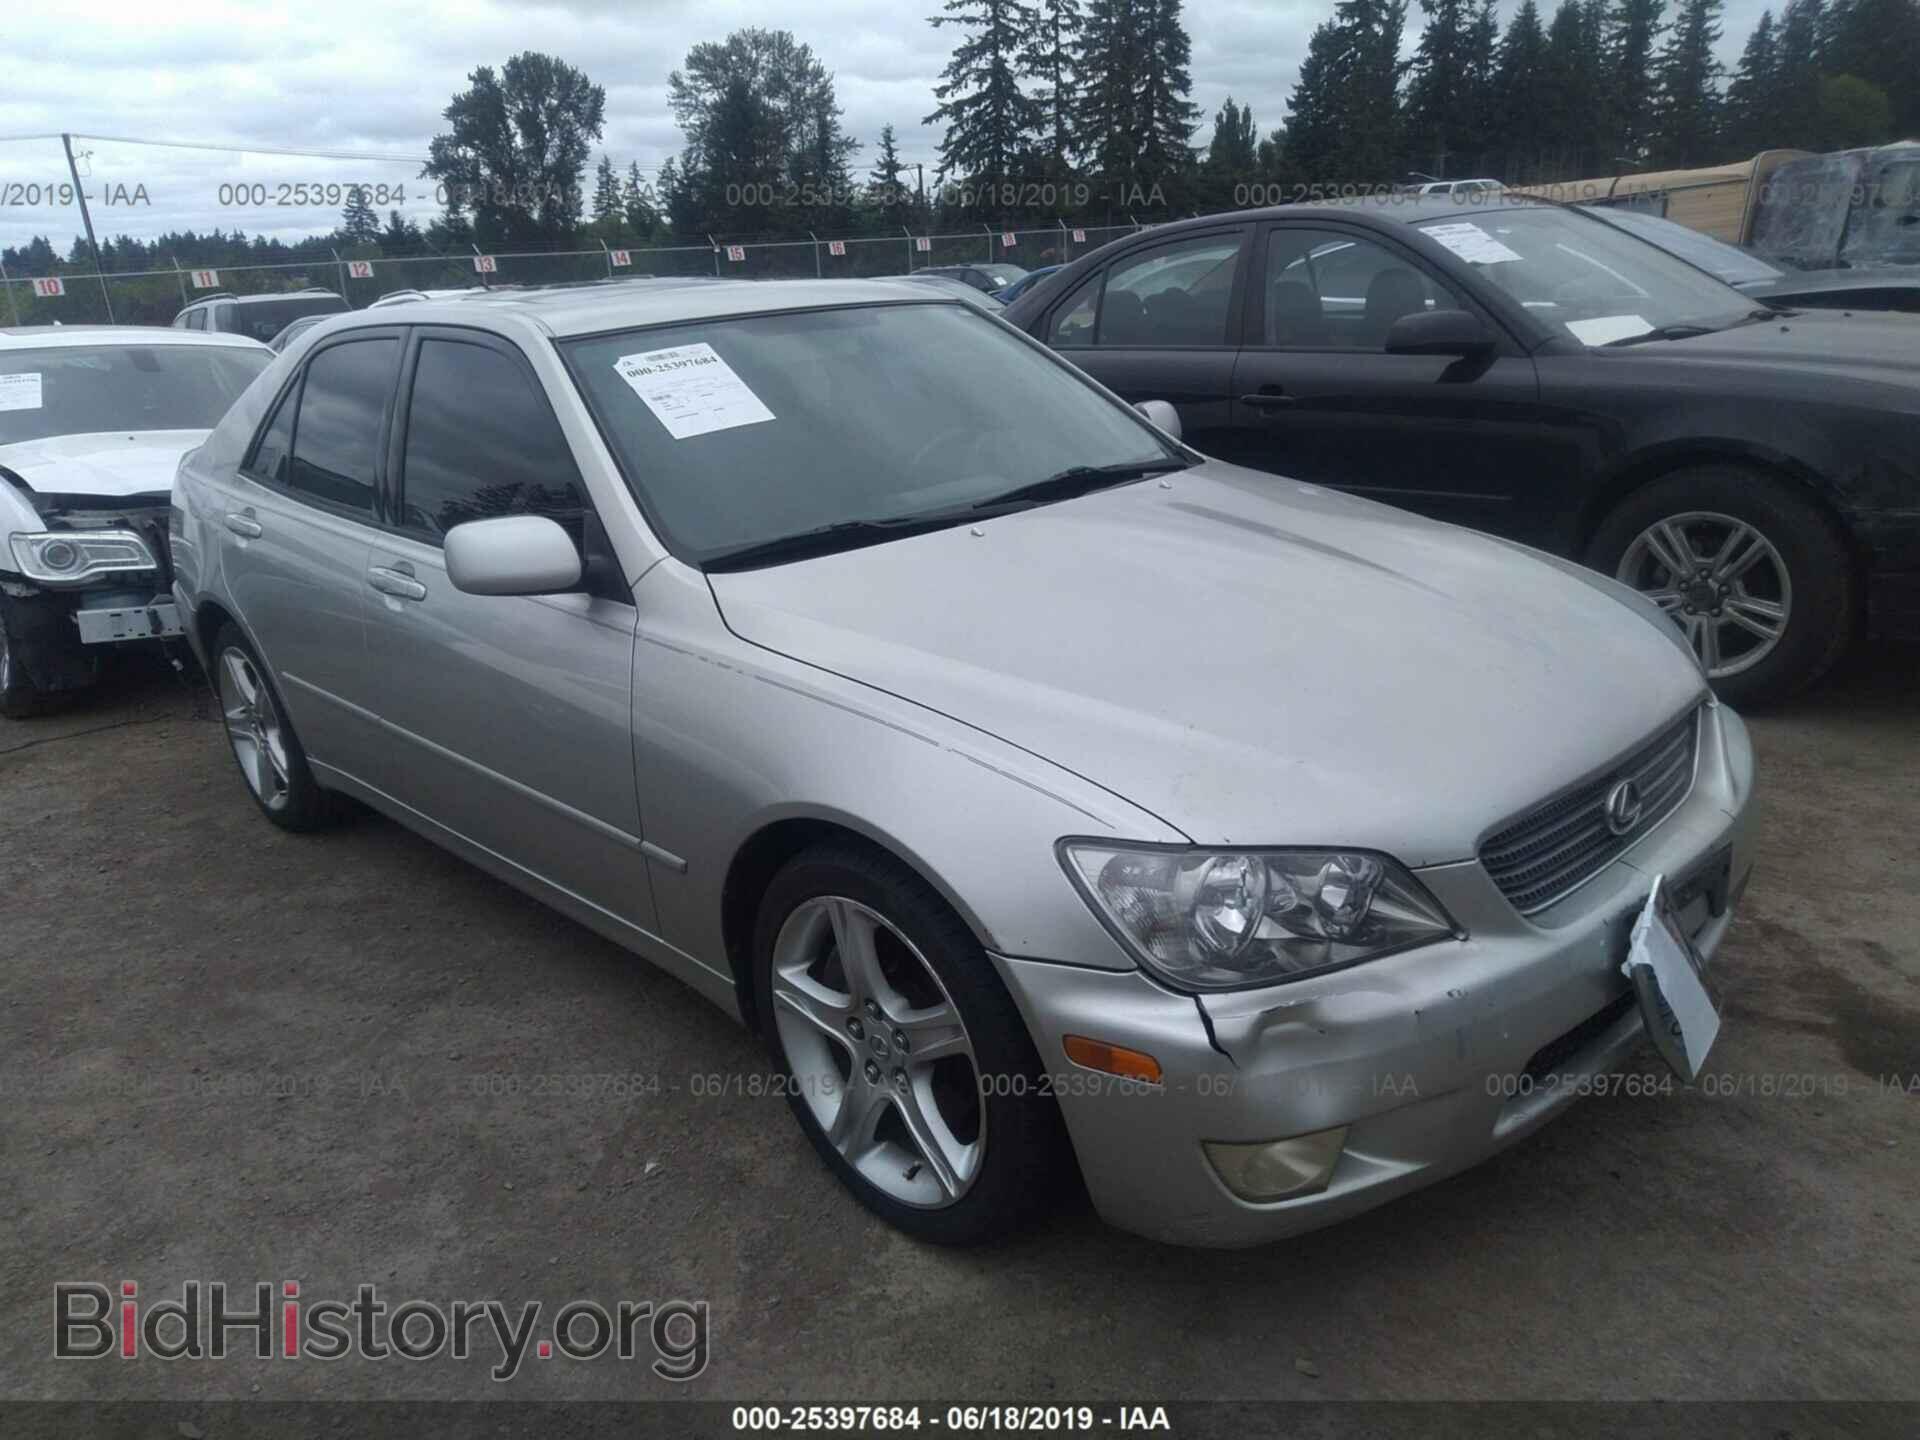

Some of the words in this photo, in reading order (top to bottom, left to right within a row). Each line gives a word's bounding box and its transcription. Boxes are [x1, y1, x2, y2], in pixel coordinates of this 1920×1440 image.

[613, 251, 629, 266] 14
[730, 246, 743, 260] 15
[352, 261, 370, 277] 12
[477, 257, 493, 272] 13
[38, 278, 60, 295] 10
[197, 271, 214, 287] 11
[626, 355, 718, 378] 000-25397684
